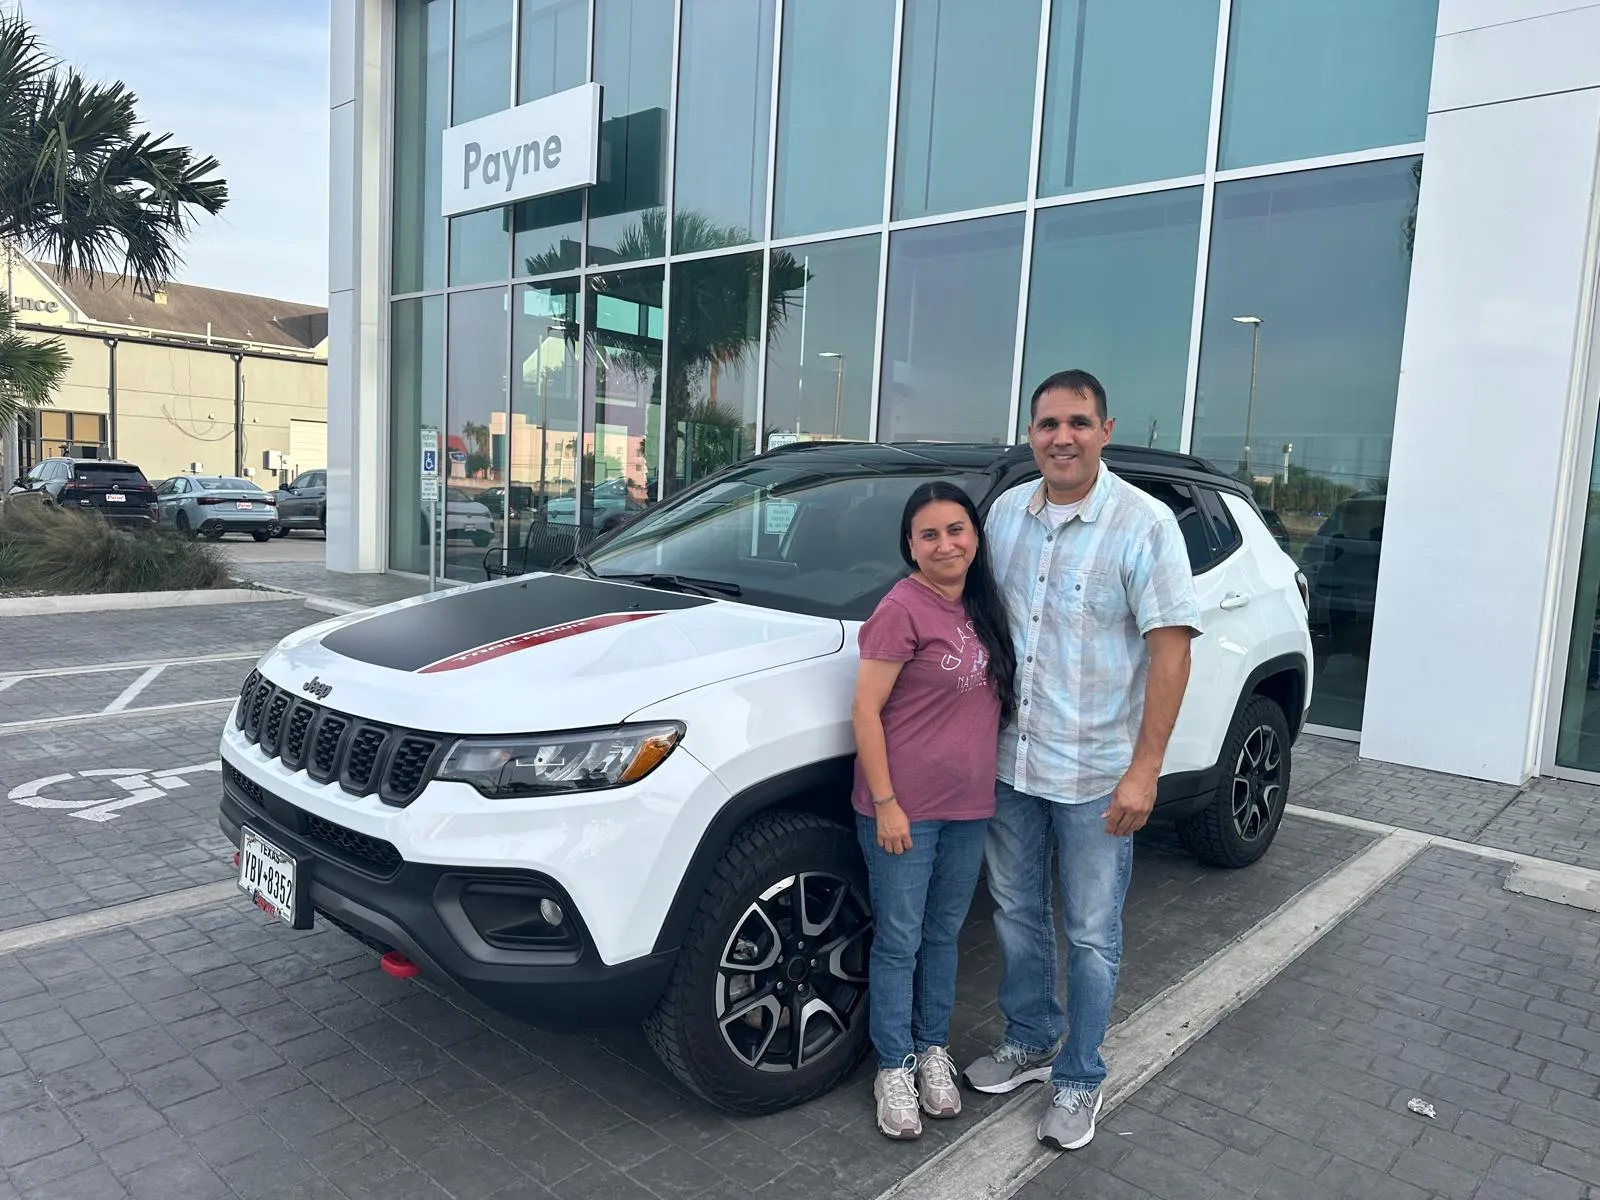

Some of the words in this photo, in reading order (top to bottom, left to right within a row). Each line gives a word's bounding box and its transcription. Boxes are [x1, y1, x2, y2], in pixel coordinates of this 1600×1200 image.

[463, 135, 562, 192] Payne
[302, 676, 333, 700] Jeep
[260, 843, 281, 865] TEXAS
